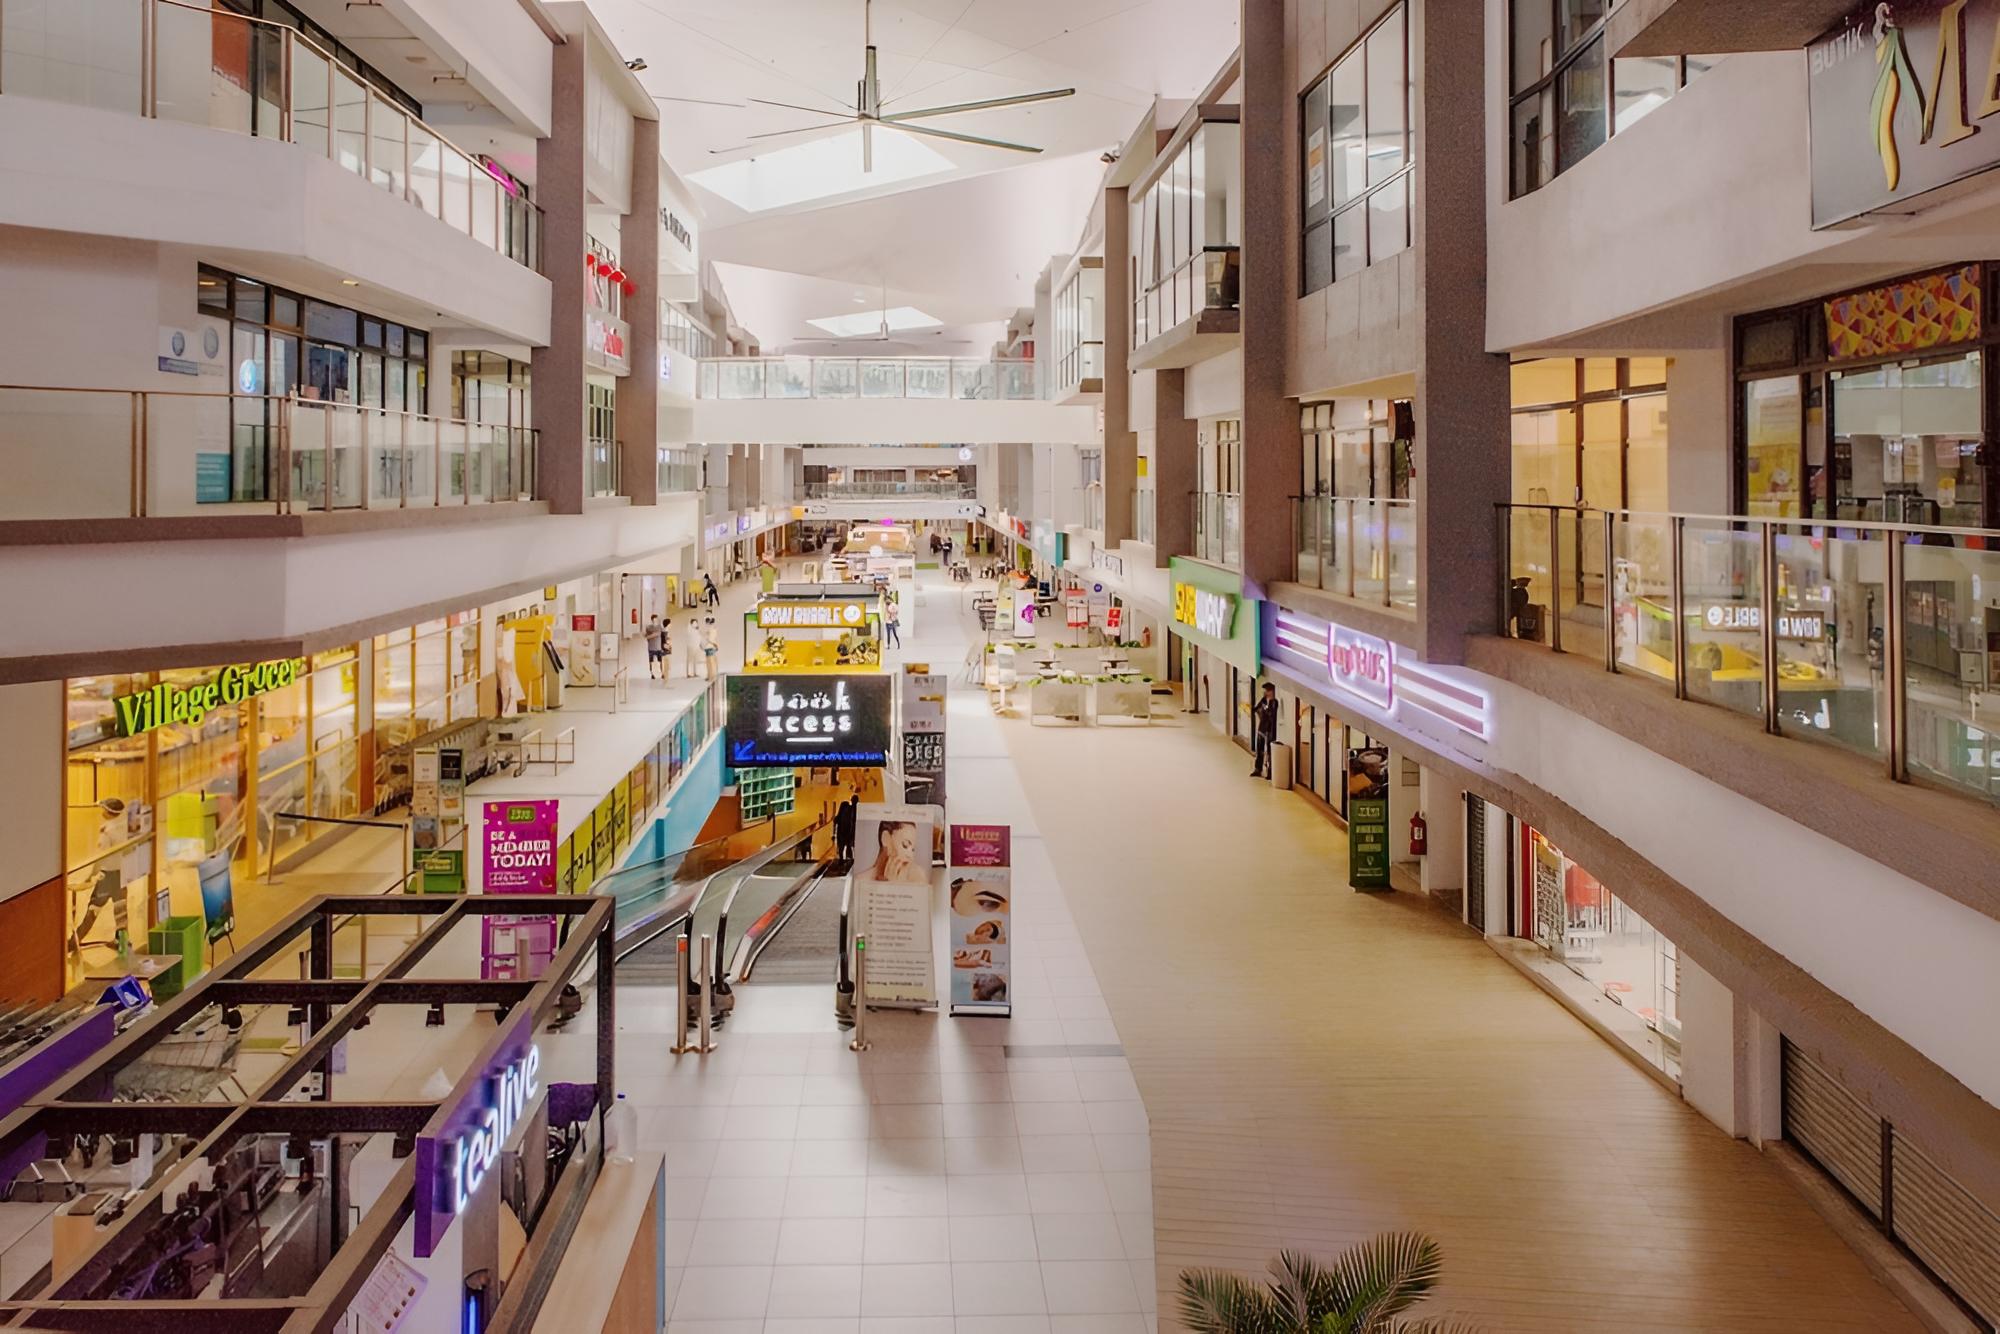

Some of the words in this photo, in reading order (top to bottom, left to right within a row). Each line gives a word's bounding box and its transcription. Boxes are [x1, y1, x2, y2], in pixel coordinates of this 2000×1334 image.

[115, 682, 219, 737] Village
[219, 656, 305, 705] Grocer
[765, 714, 852, 734] xcess
[490, 853, 551, 868] TODAY!
[454, 1043, 540, 1216] tealive
